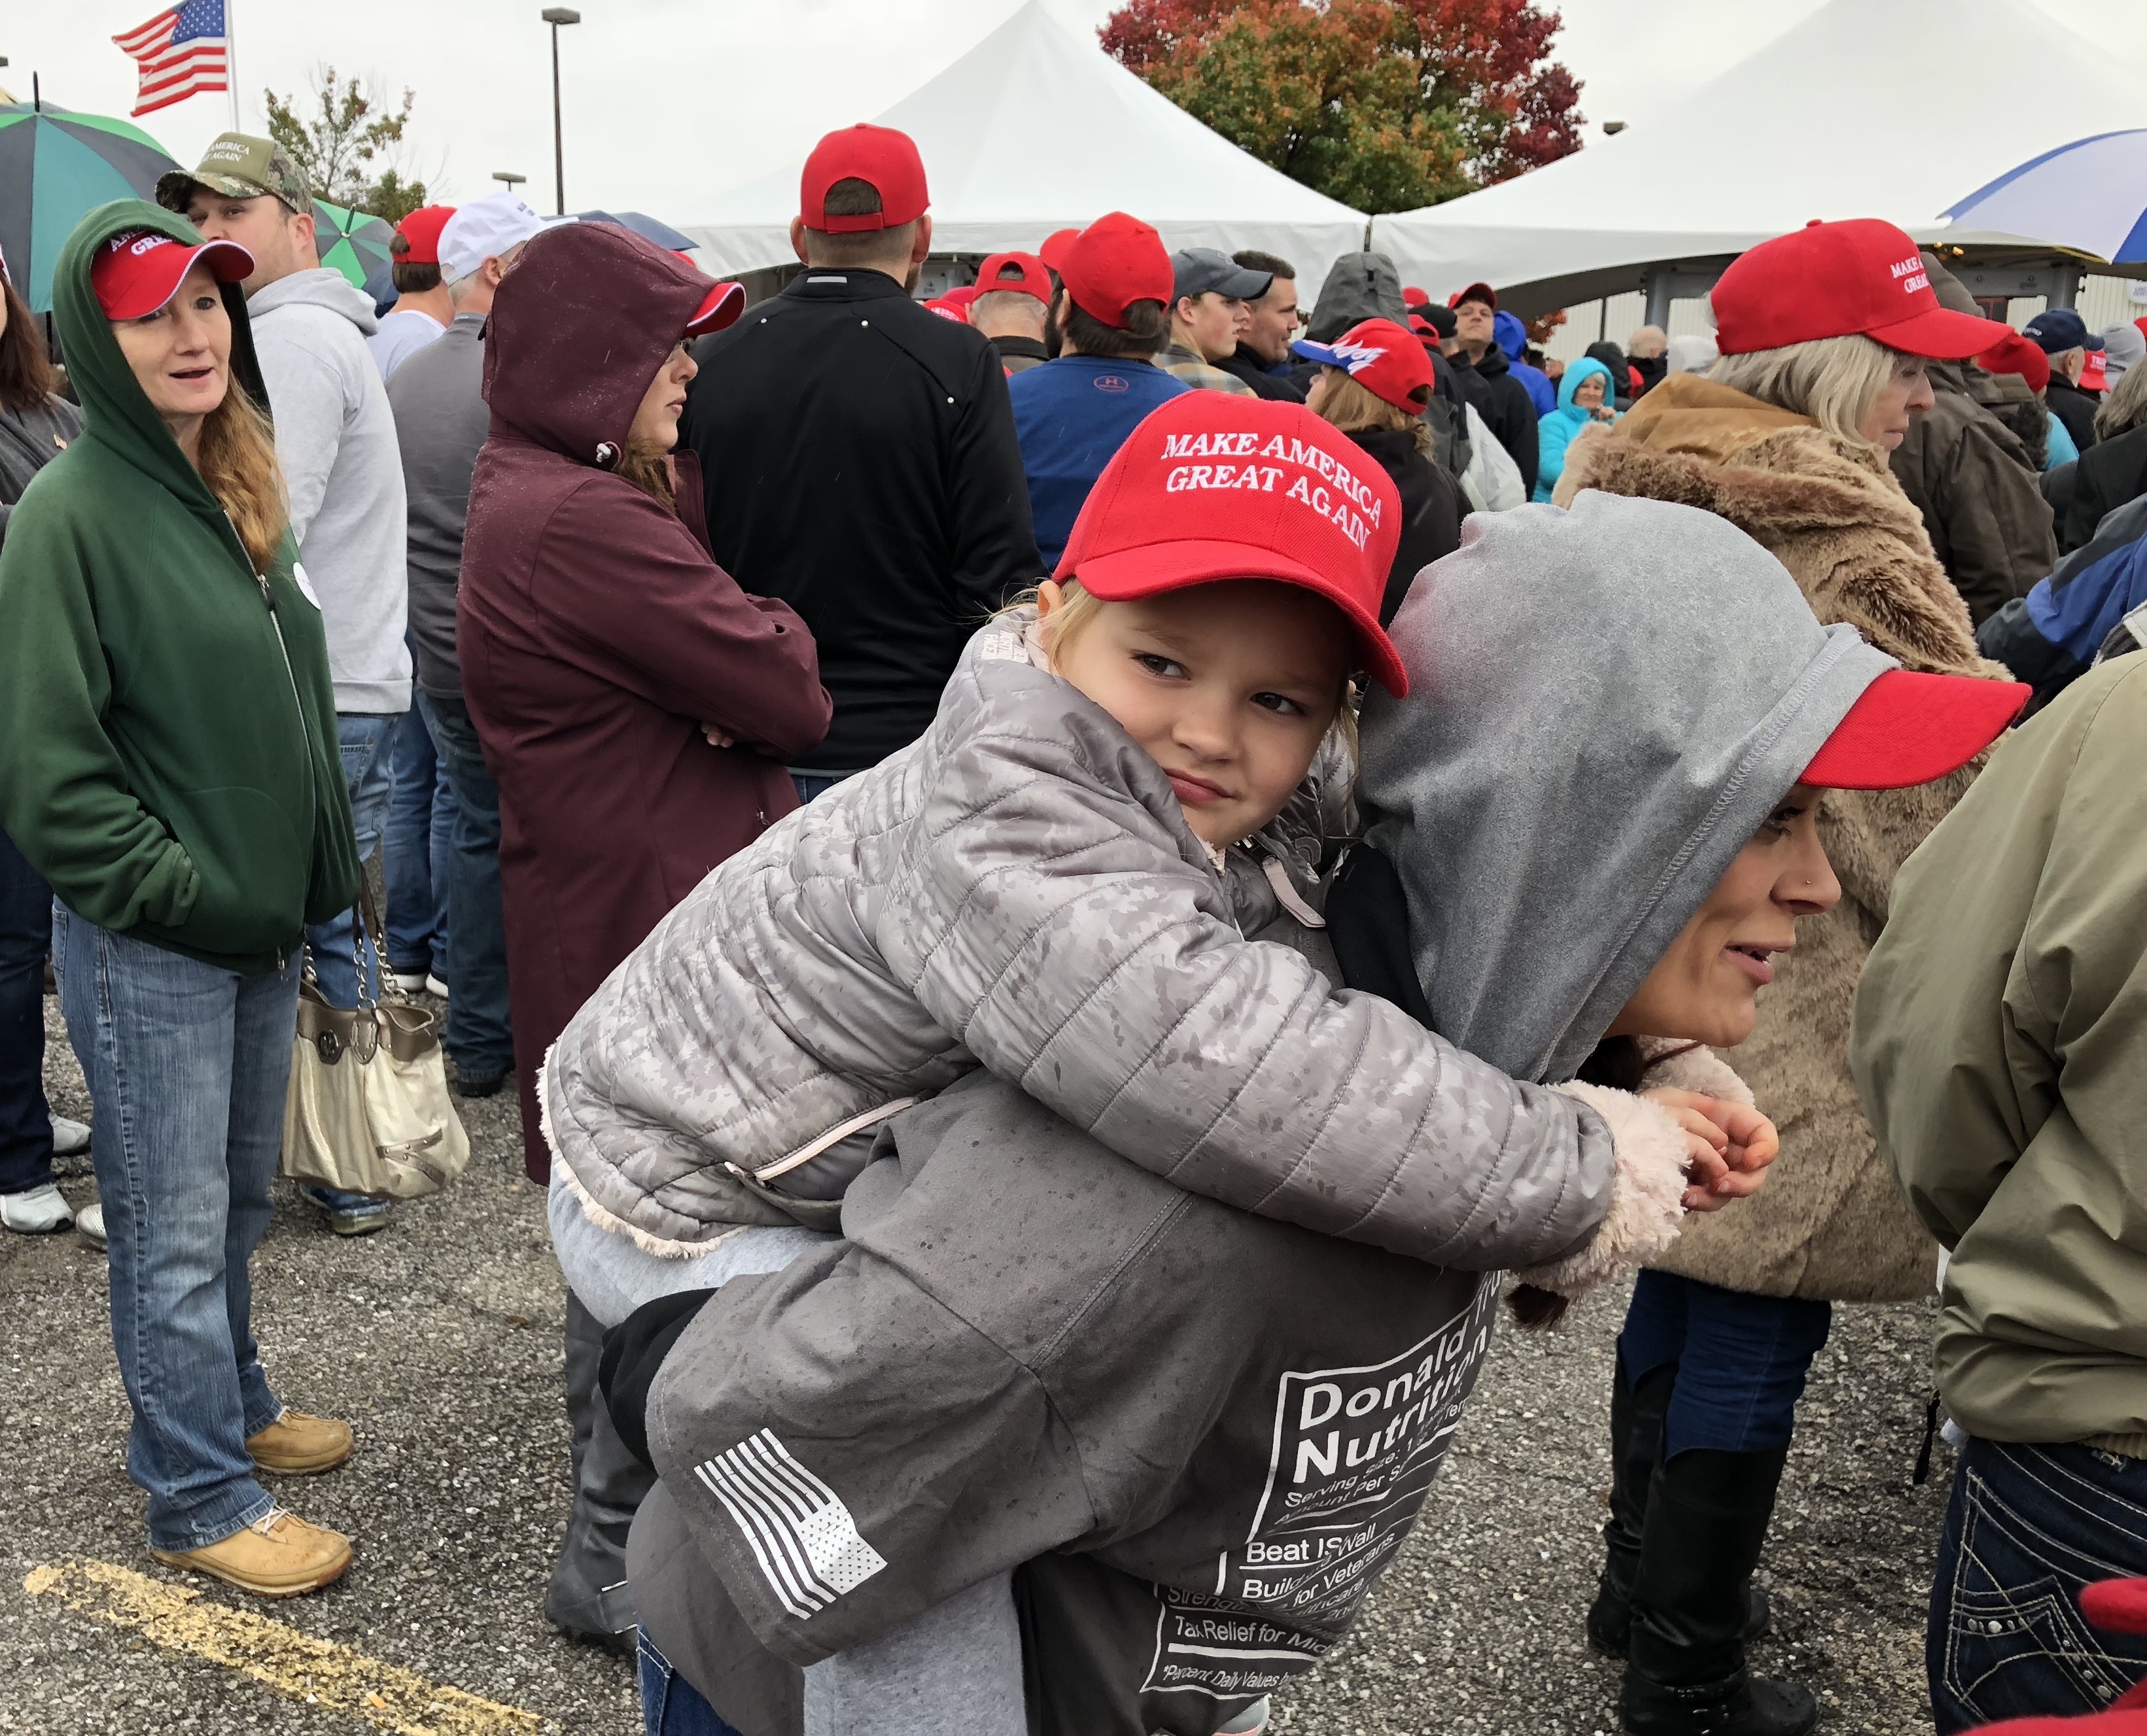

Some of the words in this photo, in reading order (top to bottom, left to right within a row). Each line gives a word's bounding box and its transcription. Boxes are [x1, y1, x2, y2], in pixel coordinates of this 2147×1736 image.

[1889, 256, 1919, 279] MAKE
[1160, 432, 1259, 460] MAKE
[1259, 434, 1382, 530] AMERICA
[1166, 464, 1285, 493] GREAT
[1285, 476, 1372, 553] AGAIN
[1299, 1315, 1470, 1431] Donald
[1475, 1270, 1501, 1327] Tru
[1293, 1325, 1487, 1484] Nutrition
[1285, 1474, 1358, 1508] Serving
[1353, 1472, 1387, 1497] Per
[1242, 1574, 1306, 1598] Build
[1338, 1522, 1376, 1556] Wall
[1247, 1539, 1310, 1563] Beat
[1293, 1584, 1319, 1608] for
[1323, 1533, 1395, 1589] Veterans
[1175, 1615, 1205, 1639] Tax
[1202, 1620, 1257, 1642] Relief
[1257, 1623, 1287, 1642] for
[1210, 1670, 1243, 1692] Daily
[1242, 1670, 1280, 1688] Values
